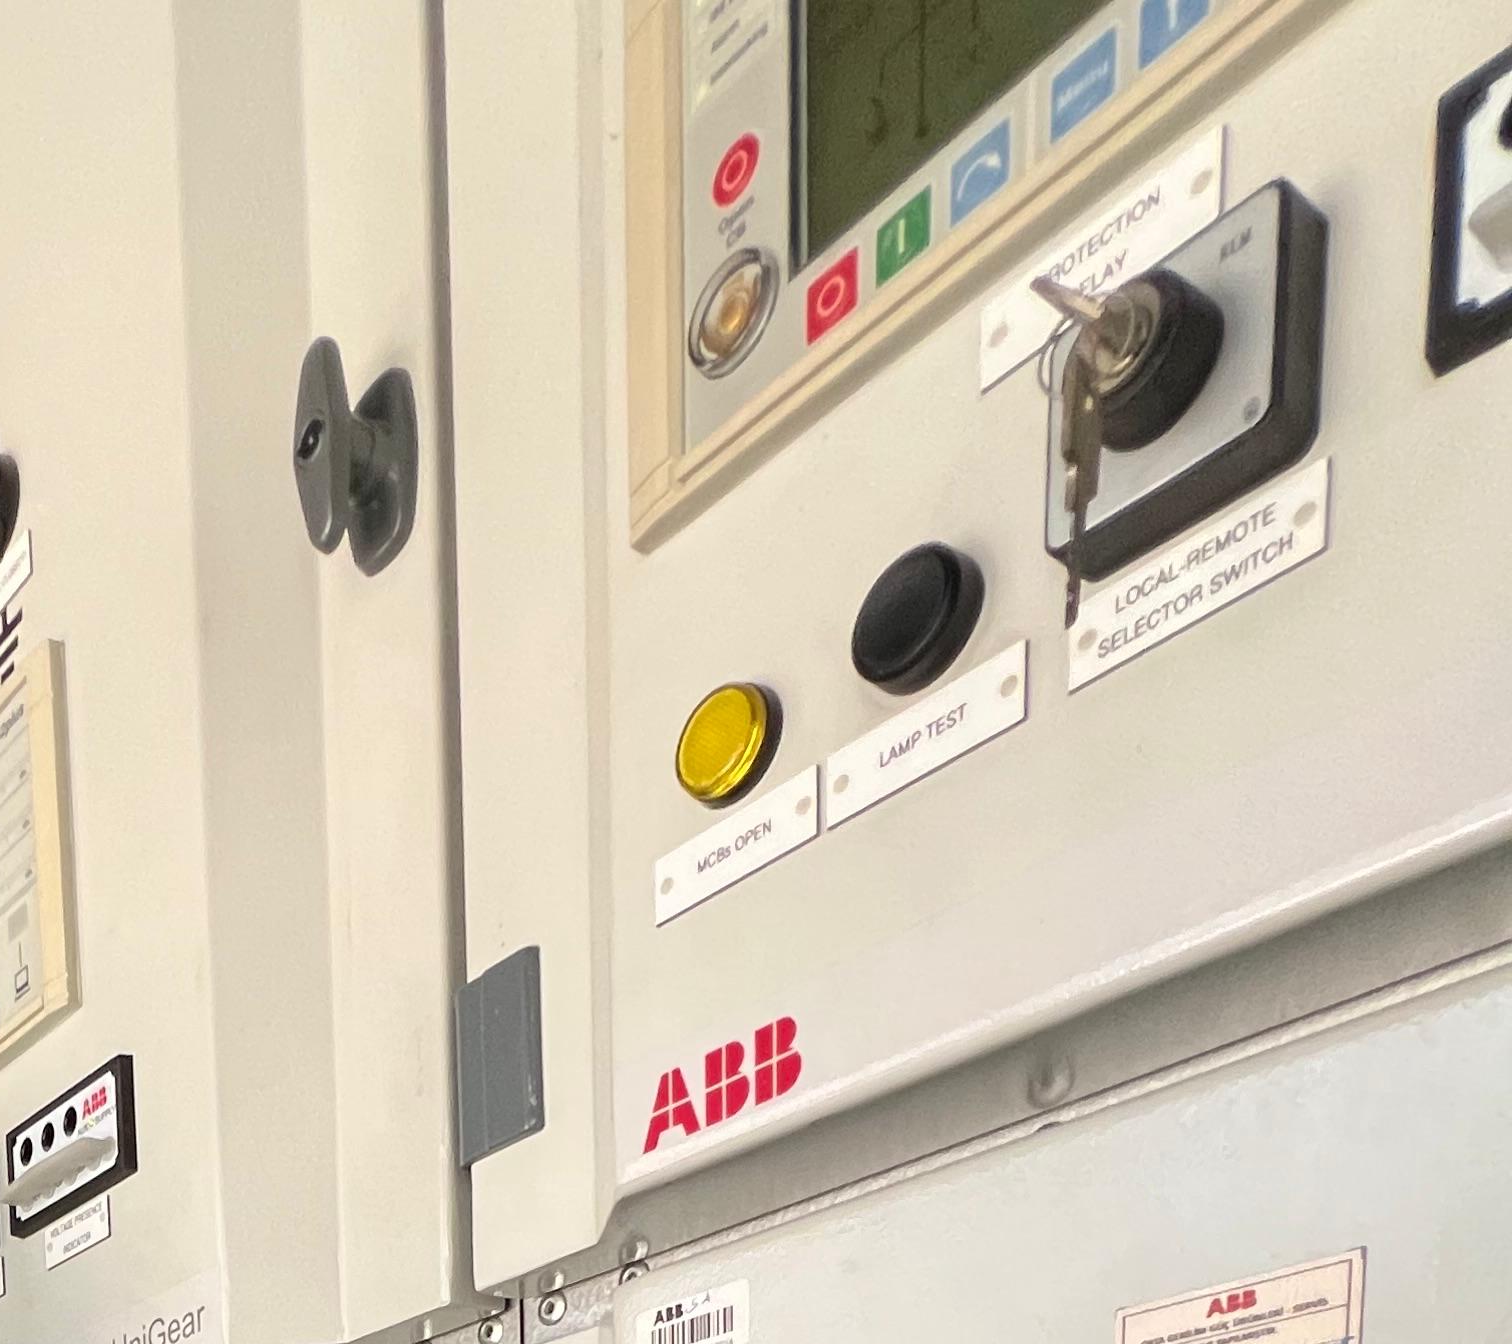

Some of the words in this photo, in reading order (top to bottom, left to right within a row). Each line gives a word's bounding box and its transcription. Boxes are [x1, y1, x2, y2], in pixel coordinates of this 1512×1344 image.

[1049, 185, 1161, 283] ROTECTION
[1079, 249, 1128, 297] ELAY
[1115, 502, 1278, 614] LOCAL-REMOTE
[1097, 583, 1203, 659] SELECTOR
[1210, 532, 1293, 595] SWITCH
[879, 730, 923, 768] LAMP
[927, 703, 968, 740] TEST
[697, 846, 732, 874] MCBs
[734, 819, 773, 852] OPEN
[82, 1086, 108, 1121] ABB
[643, 1016, 804, 1156] ABB
[654, 1304, 684, 1327] ABB
[1206, 1289, 1257, 1319] ABB
